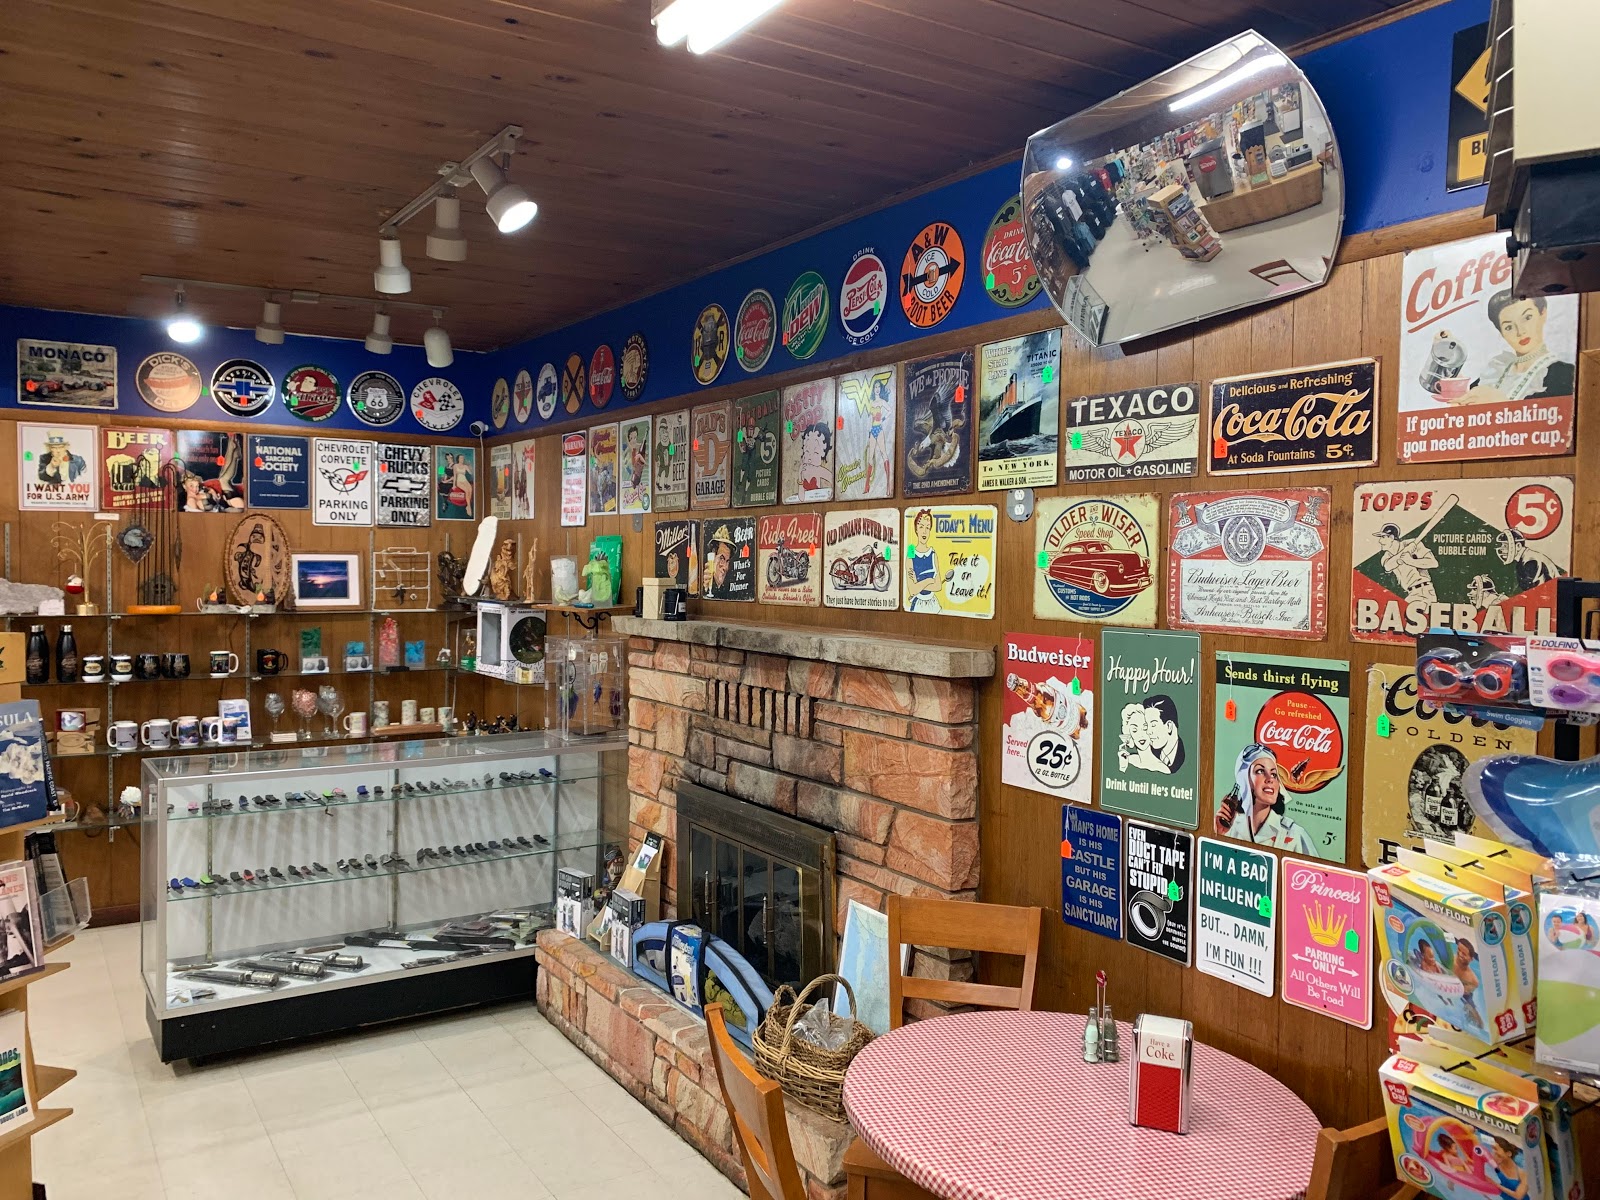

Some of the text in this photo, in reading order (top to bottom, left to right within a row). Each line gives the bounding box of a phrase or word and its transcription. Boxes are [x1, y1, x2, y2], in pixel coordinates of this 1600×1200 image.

[853, 247, 874, 261] DRINK
[925, 252, 935, 262] ICE
[922, 287, 939, 297] COLD
[930, 290, 954, 322] BEER
[846, 325, 879, 344] ICE COLD
[29, 346, 106, 363] MONACO
[985, 346, 1012, 359] WHITE
[1026, 350, 1057, 362] TITANIC
[150, 355, 191, 371] DICK'S
[988, 358, 1008, 369] STAR
[988, 369, 1007, 380] LINE
[413, 378, 462, 402] CHEVROLET
[909, 375, 925, 400] WE
[1229, 372, 1354, 397] Delicious Refreshing
[370, 399, 384, 408] 66
[1071, 387, 1194, 423] TEXACO
[1213, 388, 1371, 444] Coca-Cola
[1406, 404, 1563, 436] If you're not shaking,
[106, 431, 167, 449] BEER
[1115, 429, 1143, 437] TEXACO
[255, 446, 302, 457] NATIONAL
[318, 443, 370, 455] CHEVROLET
[1403, 430, 1565, 458] you need another cup.
[321, 455, 367, 466] CORVETTE
[384, 446, 424, 461] CHEVY
[1228, 449, 1315, 465] At Soda Fountains
[259, 462, 299, 472] SOCIETY
[380, 461, 428, 475] TRUCKS
[998, 463, 1017, 471] NEW
[1069, 462, 1191, 480] MOTOR OIL GASOLINE
[34, 484, 90, 493] WANT YOU
[696, 480, 725, 496] GARAGE
[931, 479, 959, 487] AMENDMENT
[27, 493, 90, 501] FOR ARMY
[319, 499, 368, 510] PARKING
[381, 496, 429, 509] PARKING
[1360, 491, 1433, 512] TOPPS
[330, 511, 358, 521] ONLY
[391, 510, 418, 523] ONLY
[933, 513, 993, 533] TODAY'S MENU
[760, 517, 821, 545] Ride Free!
[1048, 505, 1142, 548] OLDER AND WISER
[1075, 526, 1114, 540] Speed Shop
[826, 528, 837, 546] OLD
[1433, 533, 1493, 544] PICTURE CARDS
[1438, 546, 1487, 556] BUBBLE GUM
[733, 559, 751, 571] What's
[949, 553, 980, 566] Take it
[736, 572, 746, 581] For
[961, 571, 972, 580] or
[1187, 568, 1269, 590] Budweiser Lager
[729, 582, 749, 592] Dinner
[950, 581, 990, 599] Leave it!
[826, 595, 835, 605] They
[836, 597, 844, 605] just
[854, 597, 867, 605] better
[867, 598, 882, 606] stories
[1357, 599, 1557, 636] BASEBALL
[1541, 640, 1579, 649] DOLFINO
[1007, 642, 1091, 669] Budweiser
[1107, 655, 1195, 694] Happy Hour!
[1224, 665, 1339, 693] Sends thirst flying
[1275, 708, 1322, 721] Go refreshed
[1486, 709, 1532, 726] Swim Goggles
[1006, 735, 1029, 748] Served
[1259, 719, 1335, 753] Coca-Cola
[1035, 740, 1072, 770] 25¢
[1035, 768, 1070, 782] 12 BOTTLE
[1105, 777, 1194, 801] Drink Until He's Cute!
[1071, 819, 1118, 842] MAN'S HOME
[1128, 826, 1146, 841] EVEN
[1079, 837, 1103, 850] IS HIS
[1070, 848, 1115, 871] CASTLE
[1128, 840, 1185, 870] DUCT TAPE
[1074, 865, 1107, 881] BUT HIS
[1128, 856, 1164, 876] CAN'T FIX
[1204, 851, 1267, 883] I'M A BAD
[1066, 875, 1116, 900] GARAGE
[1129, 869, 1168, 895] STUPID
[1291, 869, 1361, 904] Princess
[1079, 895, 1103, 909] IS HIS
[1064, 902, 1118, 931] SANCTUARY
[1424, 900, 1471, 925] BABY FLOAT
[1234, 923, 1268, 952] DAMN,
[1206, 942, 1244, 969] I'M FUN
[1304, 946, 1344, 967] PARKING
[1312, 959, 1336, 975] ONLY
[1290, 968, 1361, 999] All Others Will
[1491, 955, 1502, 997] BABY FLOAT
[1307, 985, 1344, 1007] Be Toad
[1150, 1038, 1165, 1047] Have
[1146, 1046, 1175, 1062] Coke
[1455, 1105, 1517, 1134] BABY FLOAT
